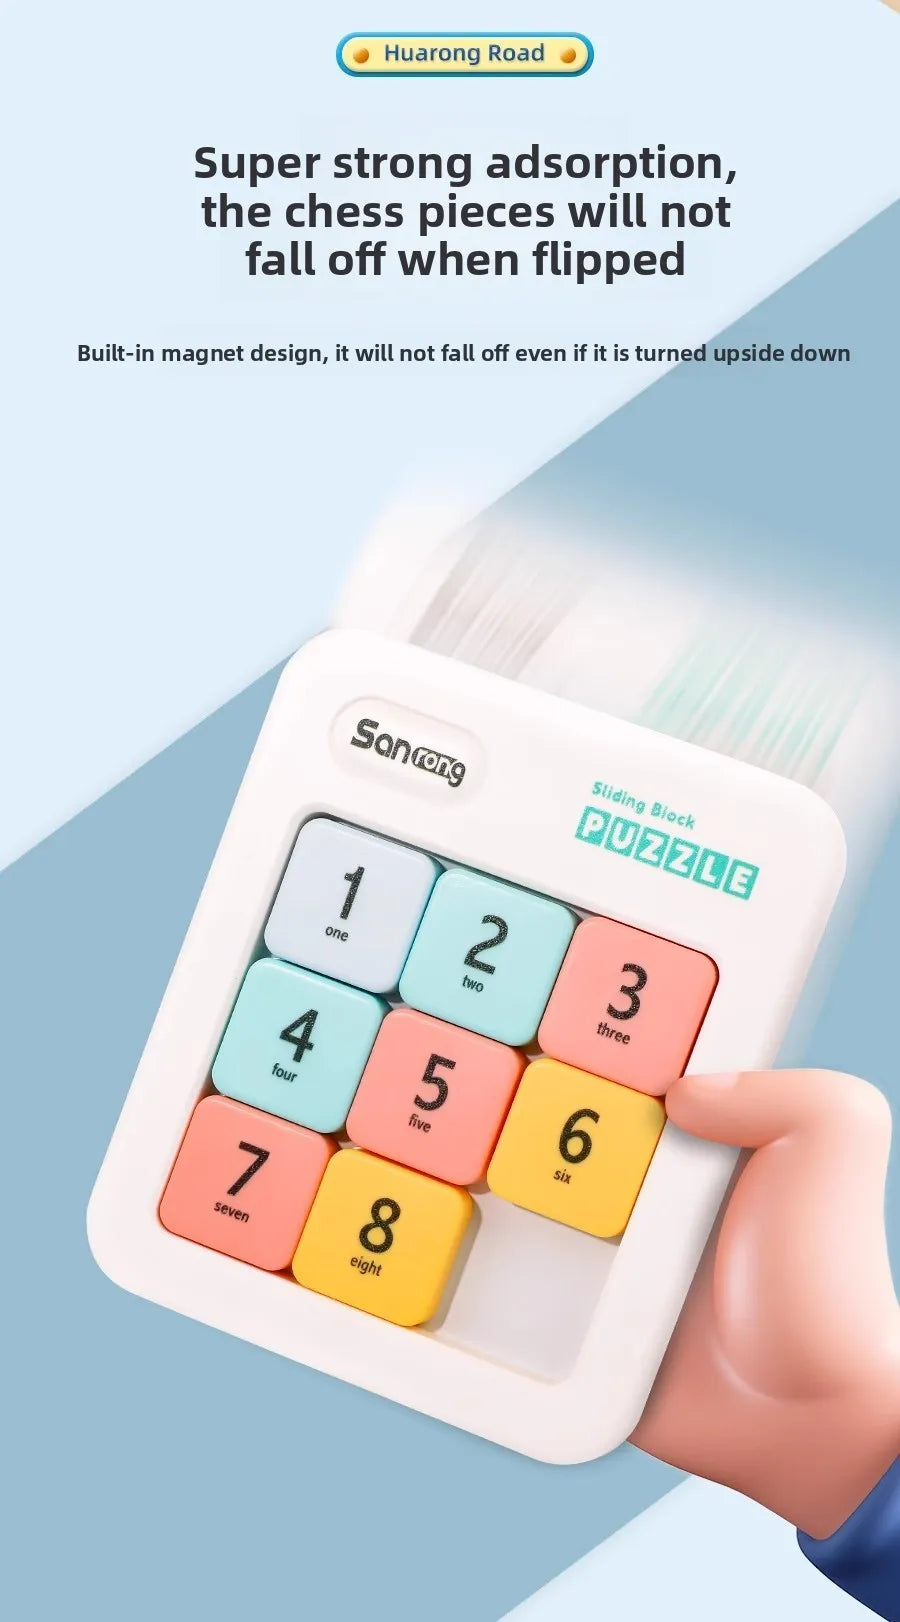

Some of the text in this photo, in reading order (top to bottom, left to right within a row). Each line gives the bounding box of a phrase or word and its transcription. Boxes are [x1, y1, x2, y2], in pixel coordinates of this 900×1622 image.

[592, 781, 696, 830] Sliding Block
[577, 806, 759, 899] PUZZLE
[340, 867, 365, 919] 1
[325, 924, 349, 944] one
[464, 914, 509, 974] 2
[461, 974, 484, 993] two
[606, 964, 648, 1022] 3
[279, 1009, 318, 1063] 4
[596, 1020, 631, 1045] three
[271, 1062, 298, 1082] four
[413, 1054, 457, 1112] 5
[408, 1113, 432, 1134] five
[558, 1108, 600, 1165] 6
[226, 1141, 271, 1197] 7
[553, 1168, 572, 1186] six
[213, 1200, 250, 1224] seven
[358, 1197, 401, 1254] 8
[349, 1254, 383, 1278] eight
